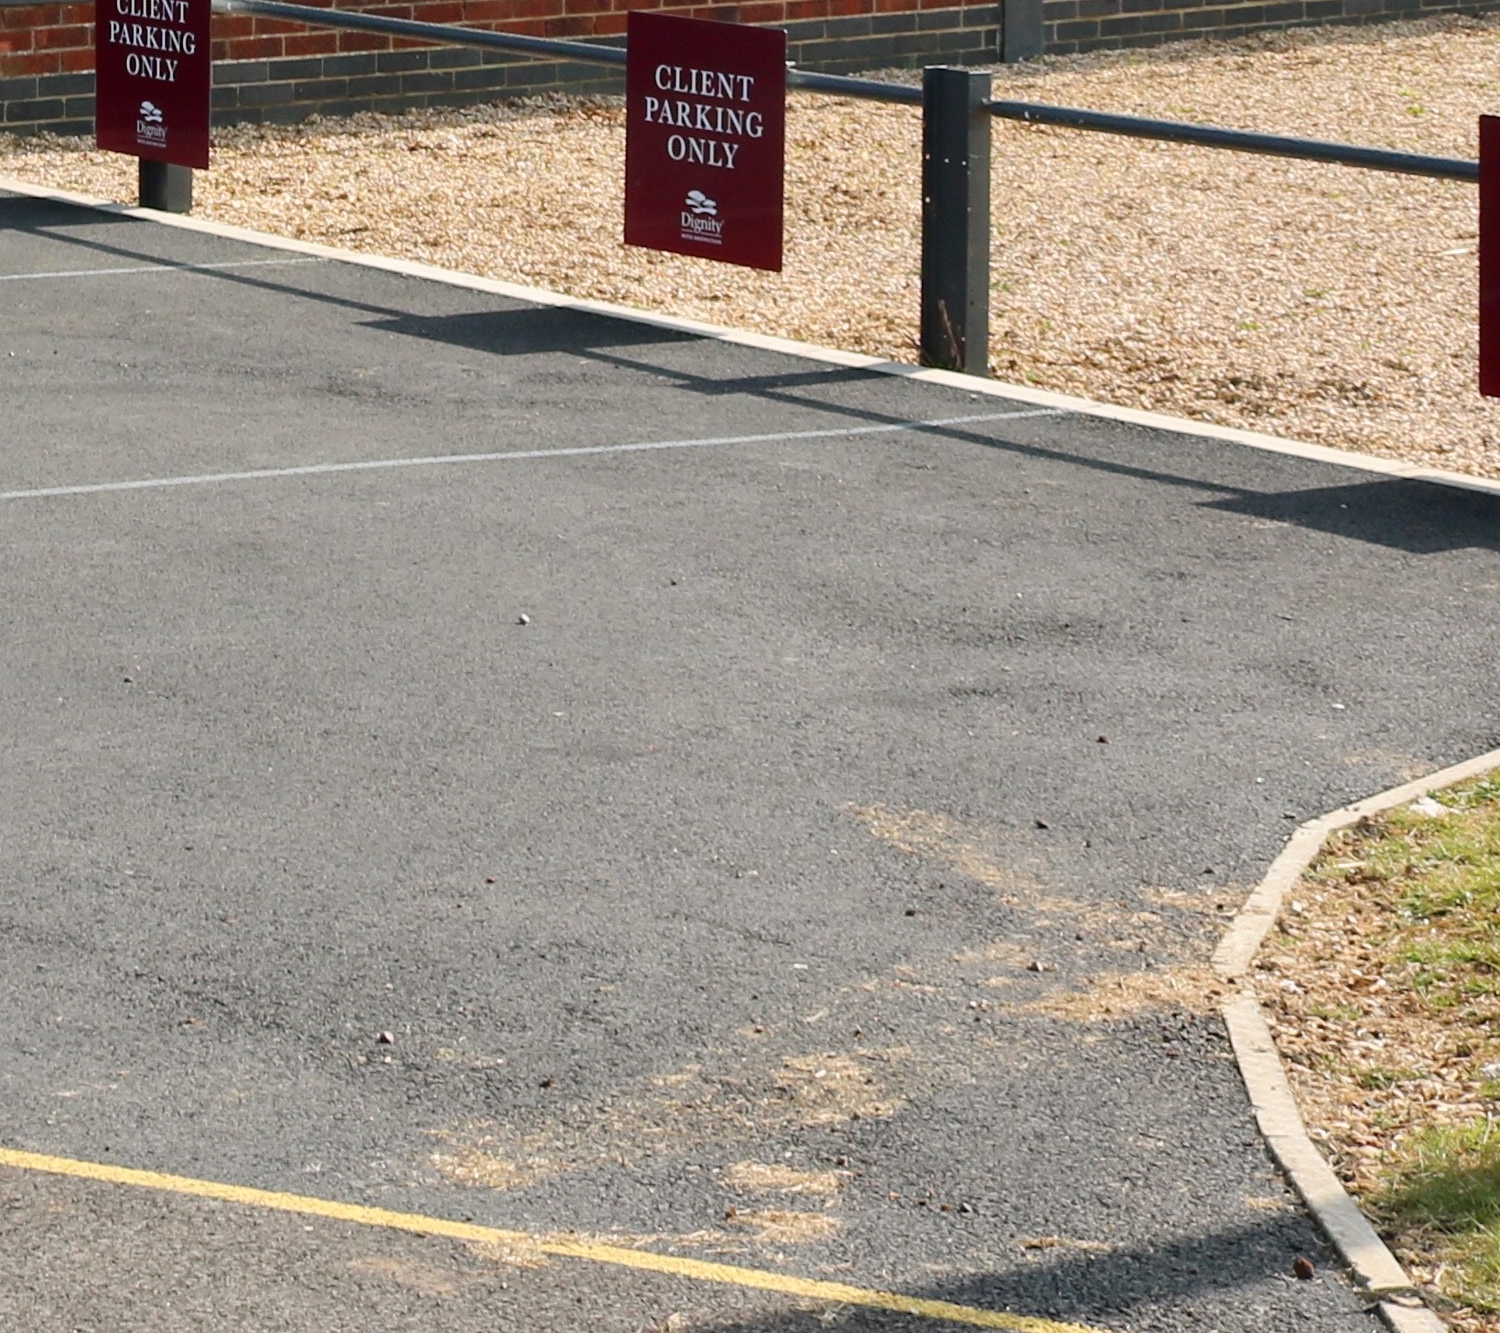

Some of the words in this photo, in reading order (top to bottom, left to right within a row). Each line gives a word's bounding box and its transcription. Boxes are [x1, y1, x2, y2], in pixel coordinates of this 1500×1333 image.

[109, 20, 196, 55] PARKING
[126, 53, 178, 82] ONLY
[655, 64, 754, 102] CLIENT
[644, 96, 764, 138] PARKING
[667, 134, 739, 170] ONLY
[681, 212, 722, 234] Dignity
